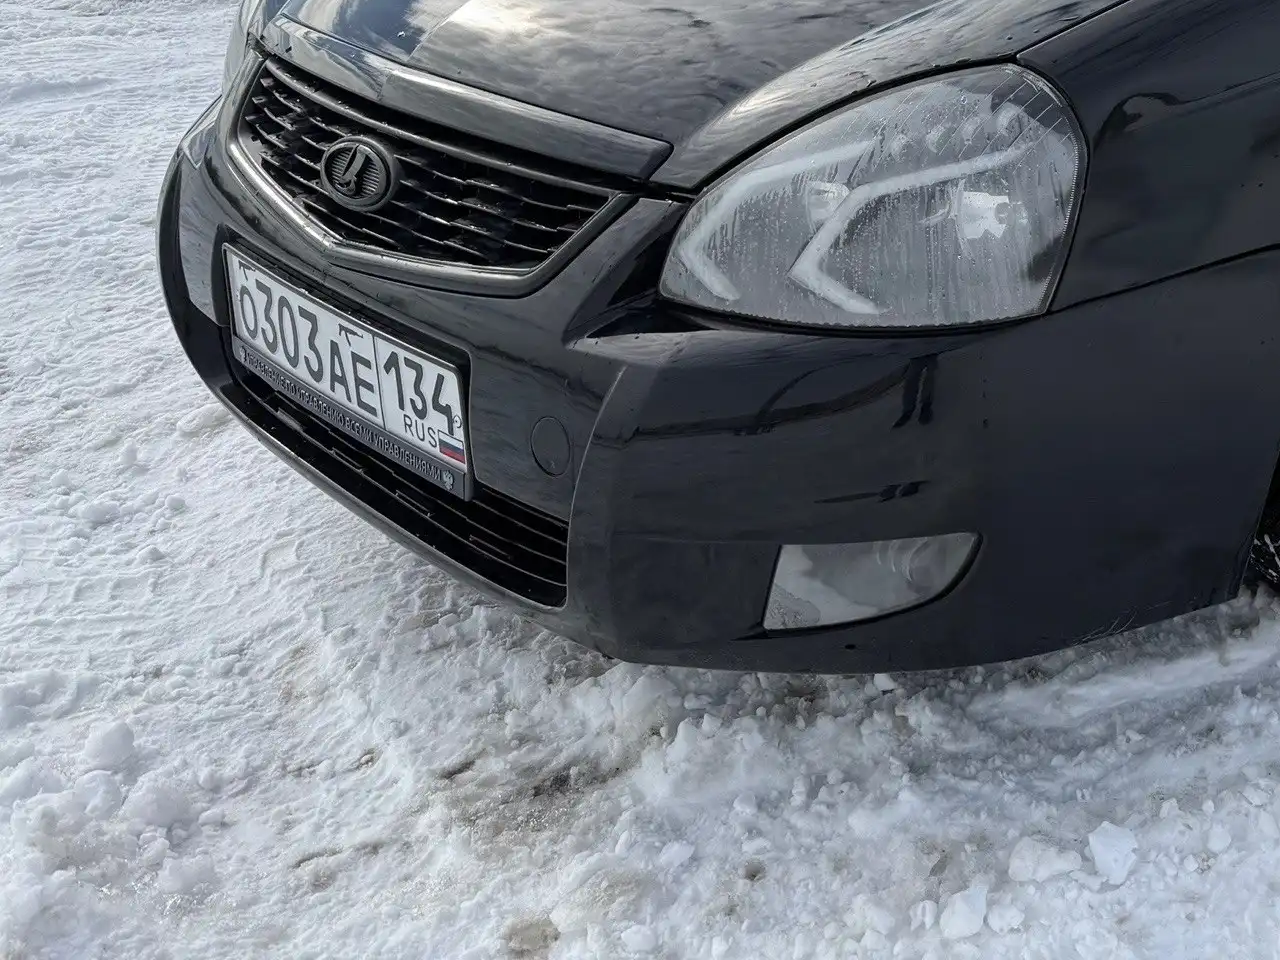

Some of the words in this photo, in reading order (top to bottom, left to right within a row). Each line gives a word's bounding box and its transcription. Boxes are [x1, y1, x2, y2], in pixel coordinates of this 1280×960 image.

[384, 351, 455, 436] 134
[345, 417, 373, 443] ВСЕМИ
[373, 431, 441, 480] УПРАВЛЕНИЯМИ
[404, 415, 438, 449] RUS
